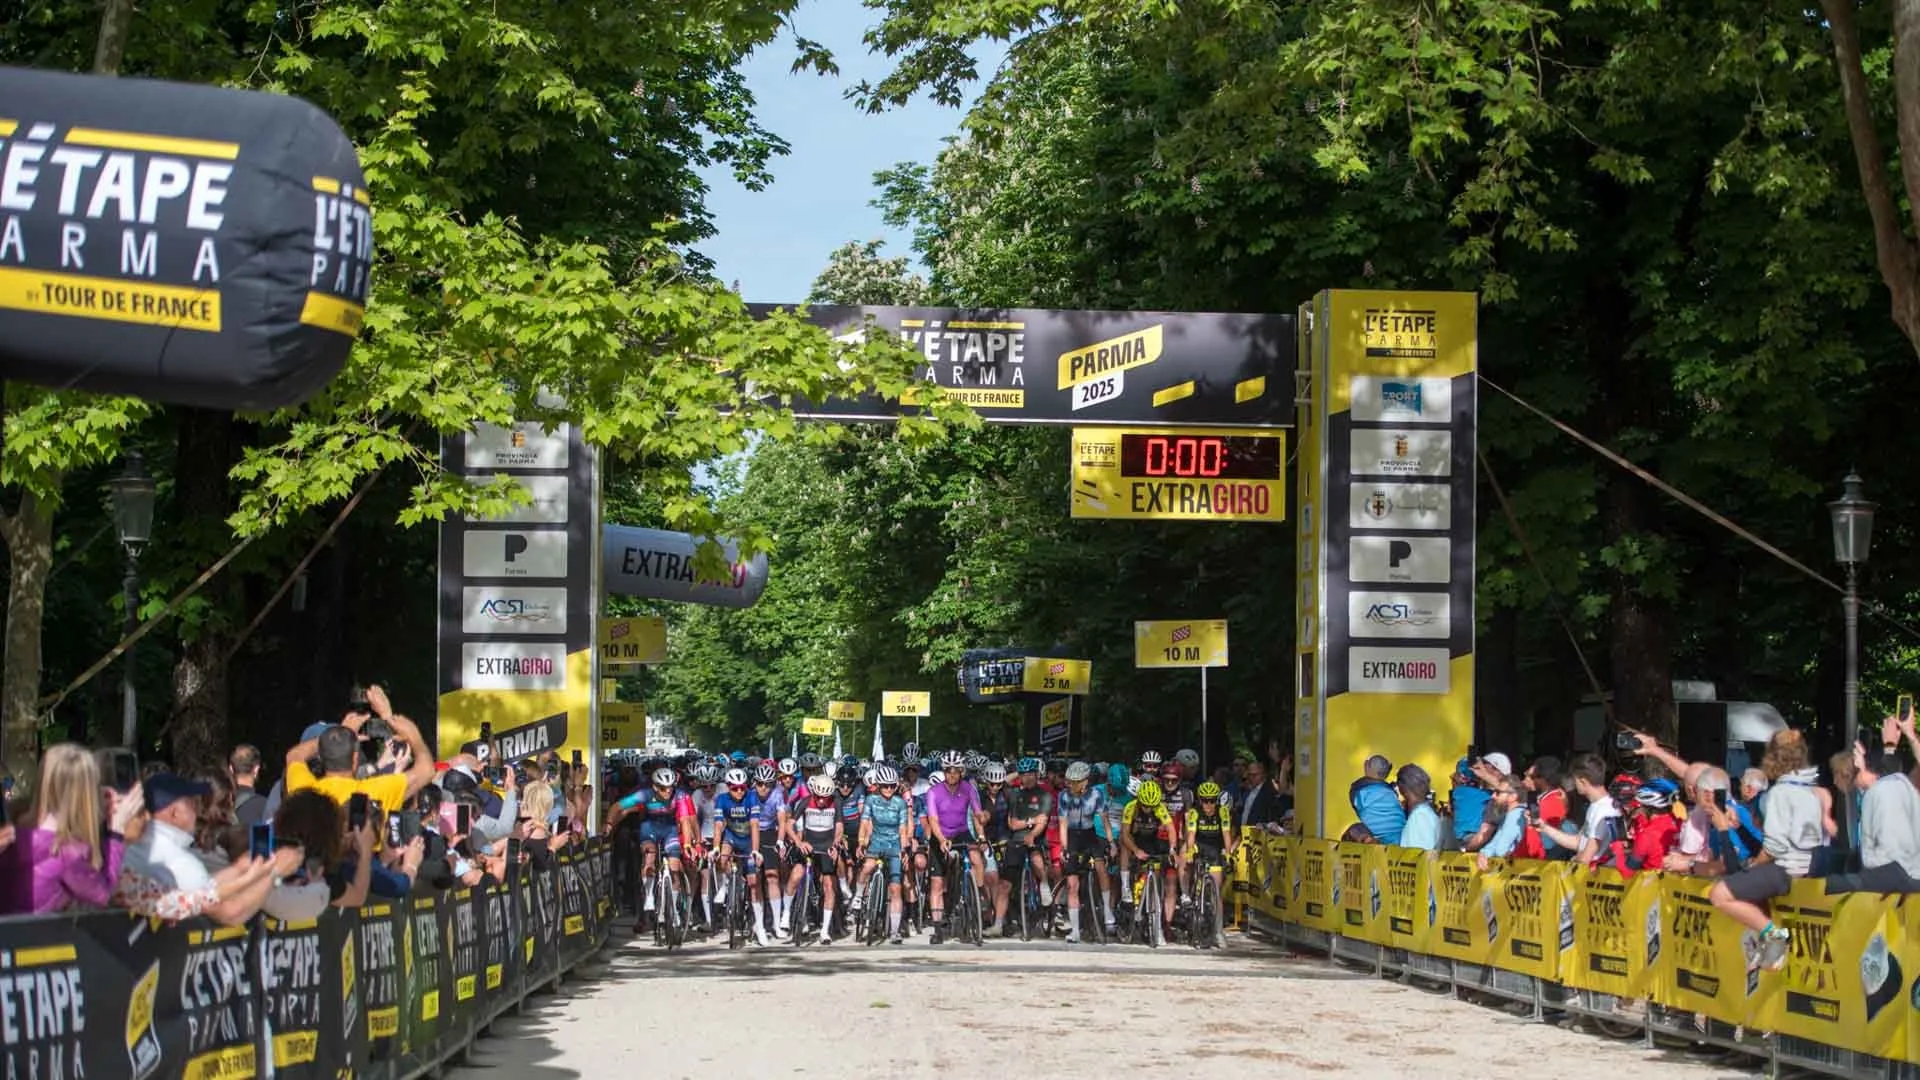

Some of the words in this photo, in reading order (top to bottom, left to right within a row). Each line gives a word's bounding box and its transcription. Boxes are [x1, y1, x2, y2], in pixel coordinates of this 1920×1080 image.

[0, 122, 235, 231] ÉTAPE
[0, 215, 219, 282] ARMA
[311, 253, 370, 297] PAR
[42, 283, 96, 308] TOUR
[102, 290, 126, 312] DE
[132, 294, 212, 321] FRANCE
[1365, 335, 1437, 346] PARMA
[1070, 336, 1147, 382] PARMA
[925, 366, 1025, 385] ARMA
[971, 393, 983, 403] DE
[984, 393, 1020, 404] FRANCE
[1082, 378, 1115, 402] 2025
[1131, 482, 1269, 514] EXTRAGIRO
[622, 547, 747, 589] EXTRAO
[602, 643, 619, 658] 10
[623, 643, 639, 657] M
[1163, 647, 1181, 661] 10
[1185, 647, 1200, 661] M
[477, 657, 552, 675] EXTRAGIRO
[979, 660, 1024, 678] L'ÉTAP
[1362, 661, 1437, 680] EXTRAGIRO
[1043, 678, 1055, 689] 25
[1058, 679, 1070, 689] M
[907, 705, 916, 713] M
[0, 952, 85, 1044] ÉTAPE
[7, 1040, 84, 1080] ARMA
